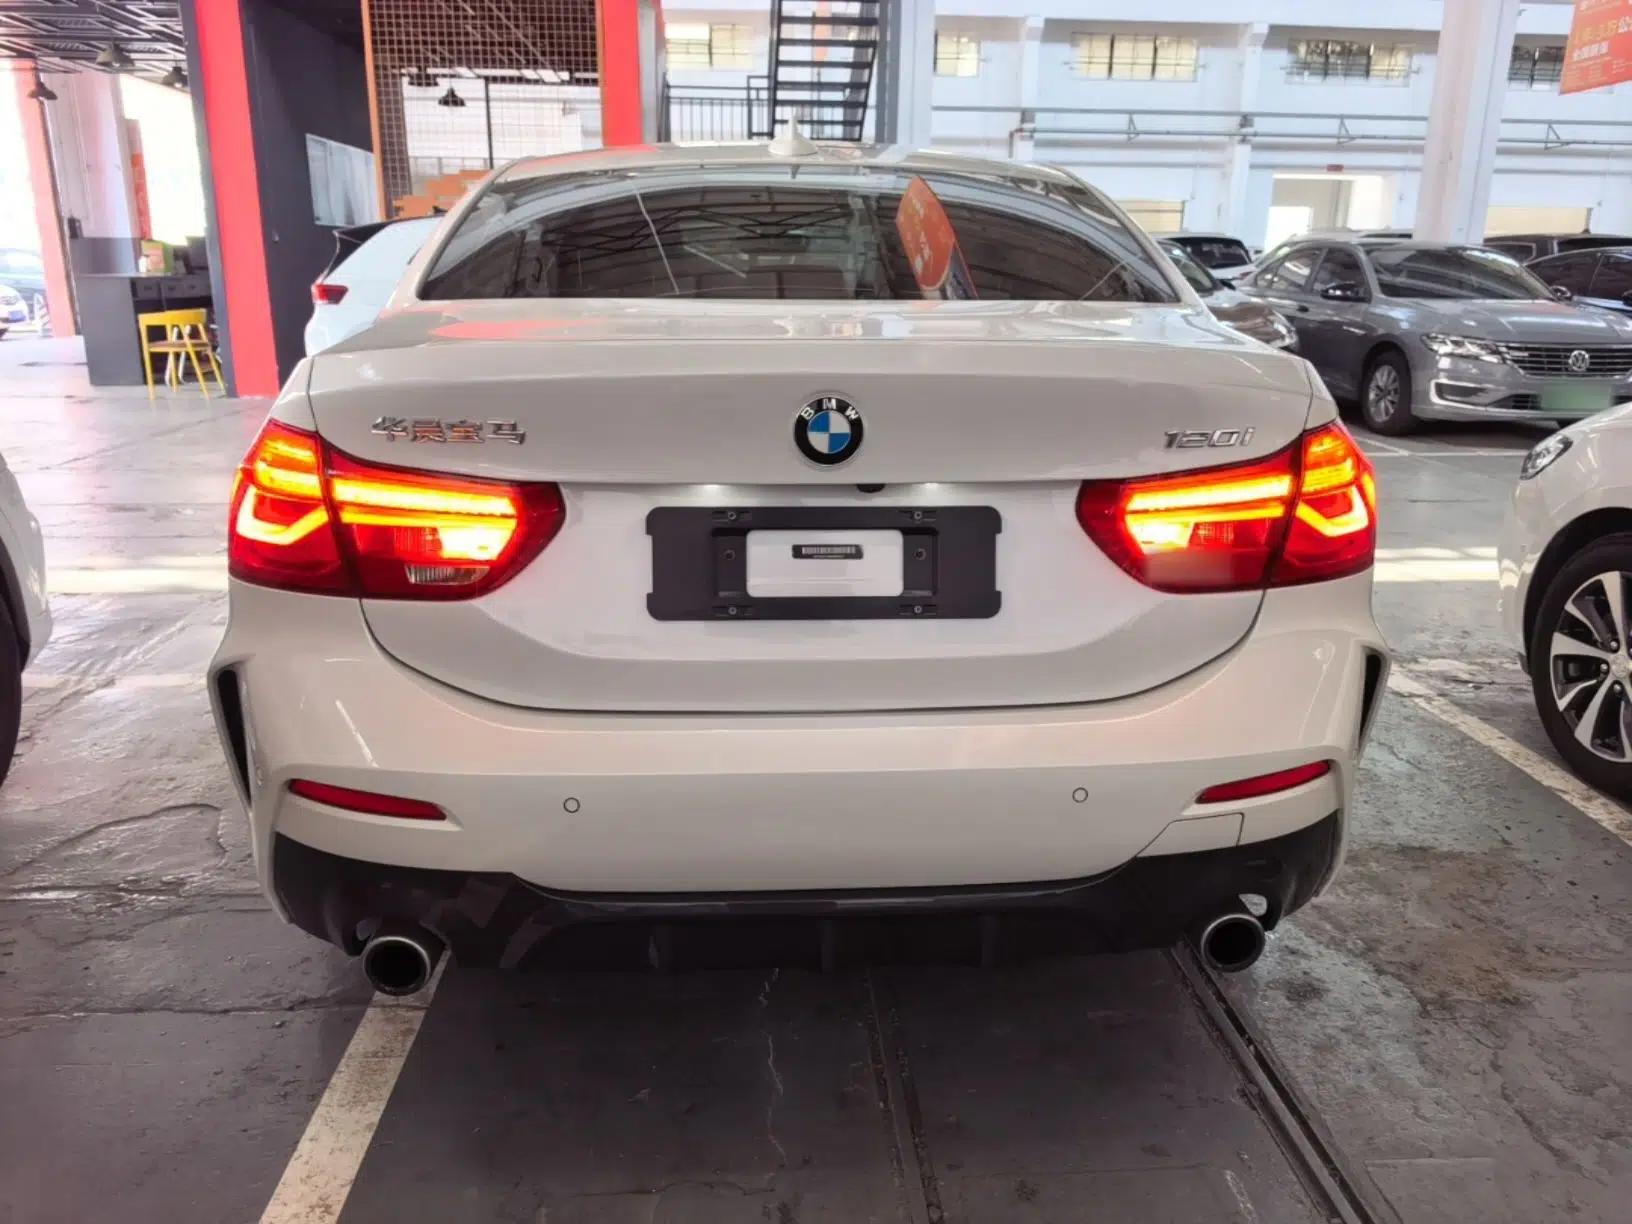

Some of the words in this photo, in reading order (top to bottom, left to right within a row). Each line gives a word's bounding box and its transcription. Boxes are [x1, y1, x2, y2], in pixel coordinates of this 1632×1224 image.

[800, 398, 859, 420] BMW
[371, 416, 526, 445] 华晨宝马
[1164, 426, 1255, 449] 120i
